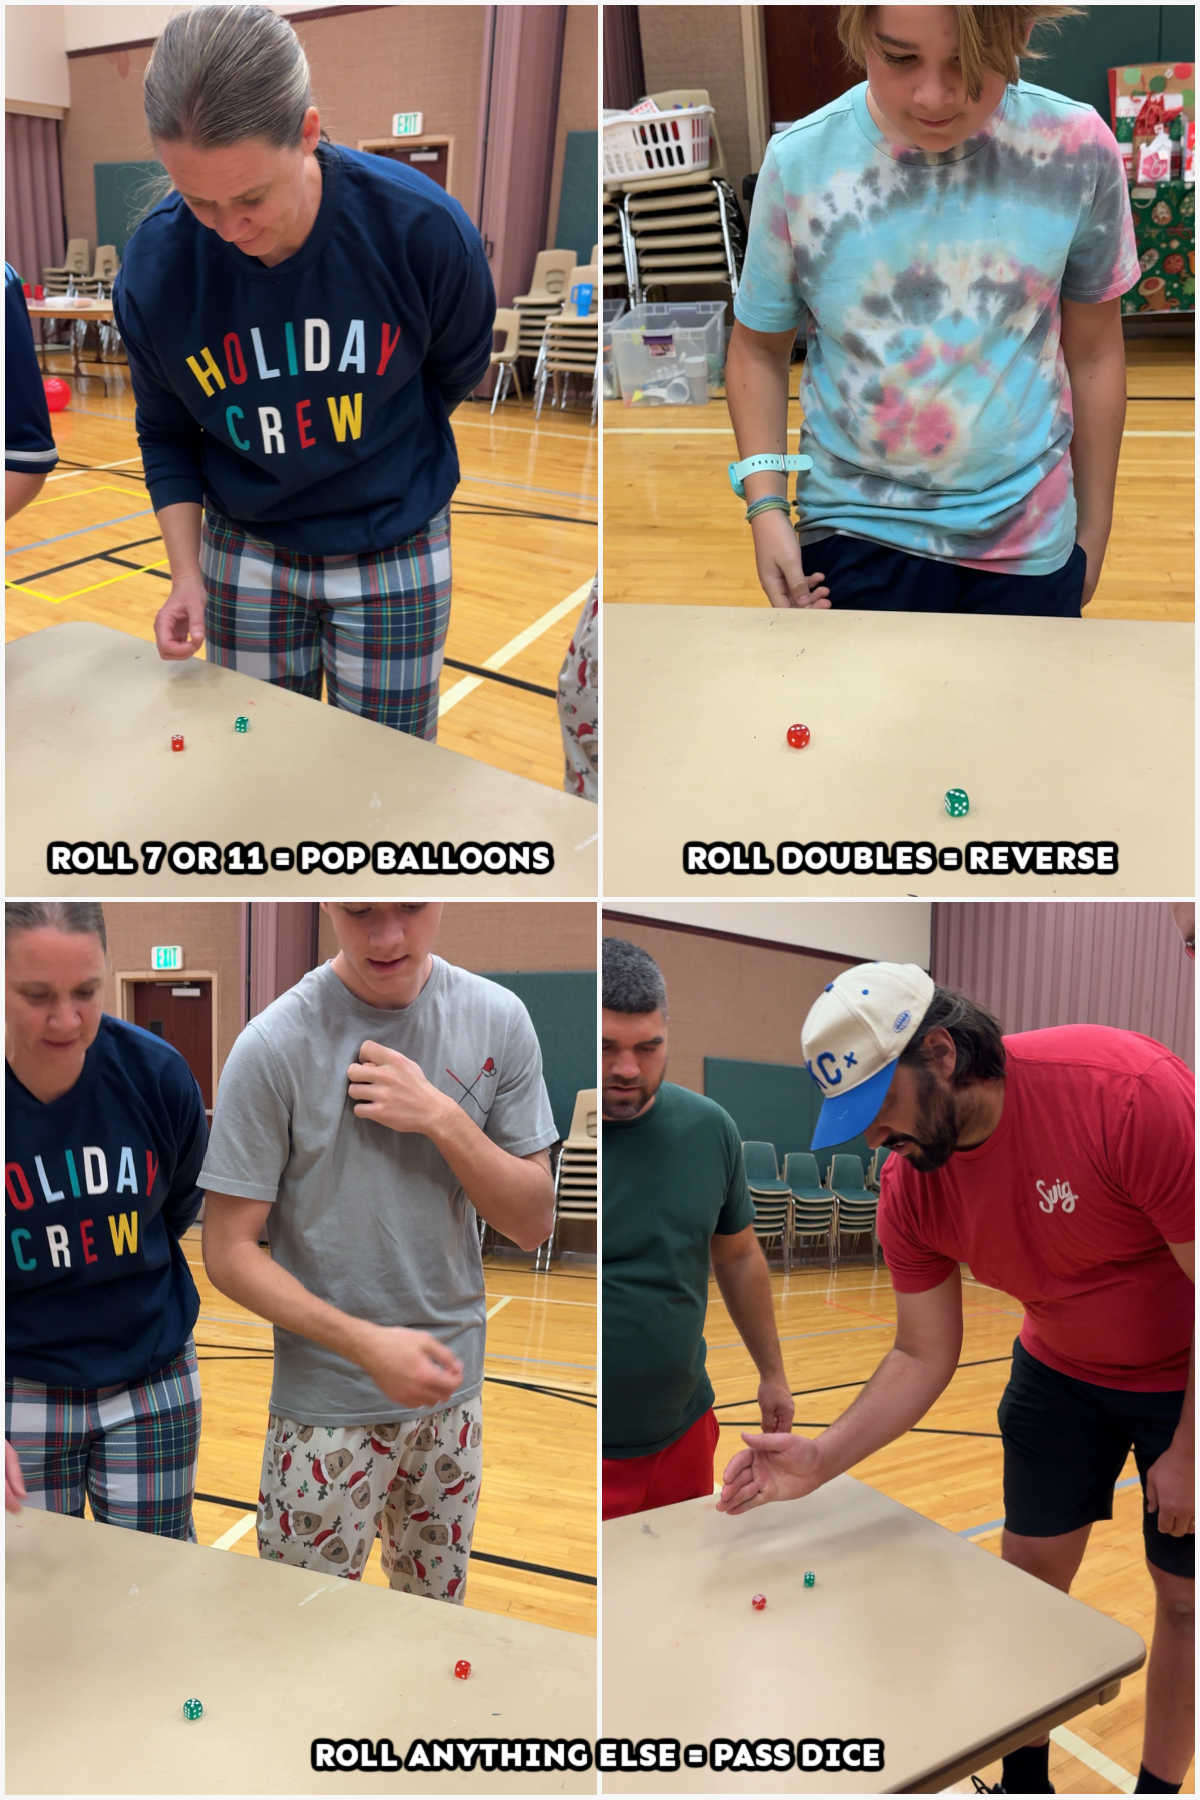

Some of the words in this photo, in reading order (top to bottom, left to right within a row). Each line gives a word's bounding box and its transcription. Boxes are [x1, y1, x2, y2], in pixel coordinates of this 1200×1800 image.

[397, 114, 418, 135] EXIT
[185, 318, 401, 398] HOLIDAY
[225, 392, 363, 454] CREW
[156, 946, 178, 969] EXIT
[5, 1146, 160, 1212] OLIDAY
[10, 1211, 138, 1271] CREW
